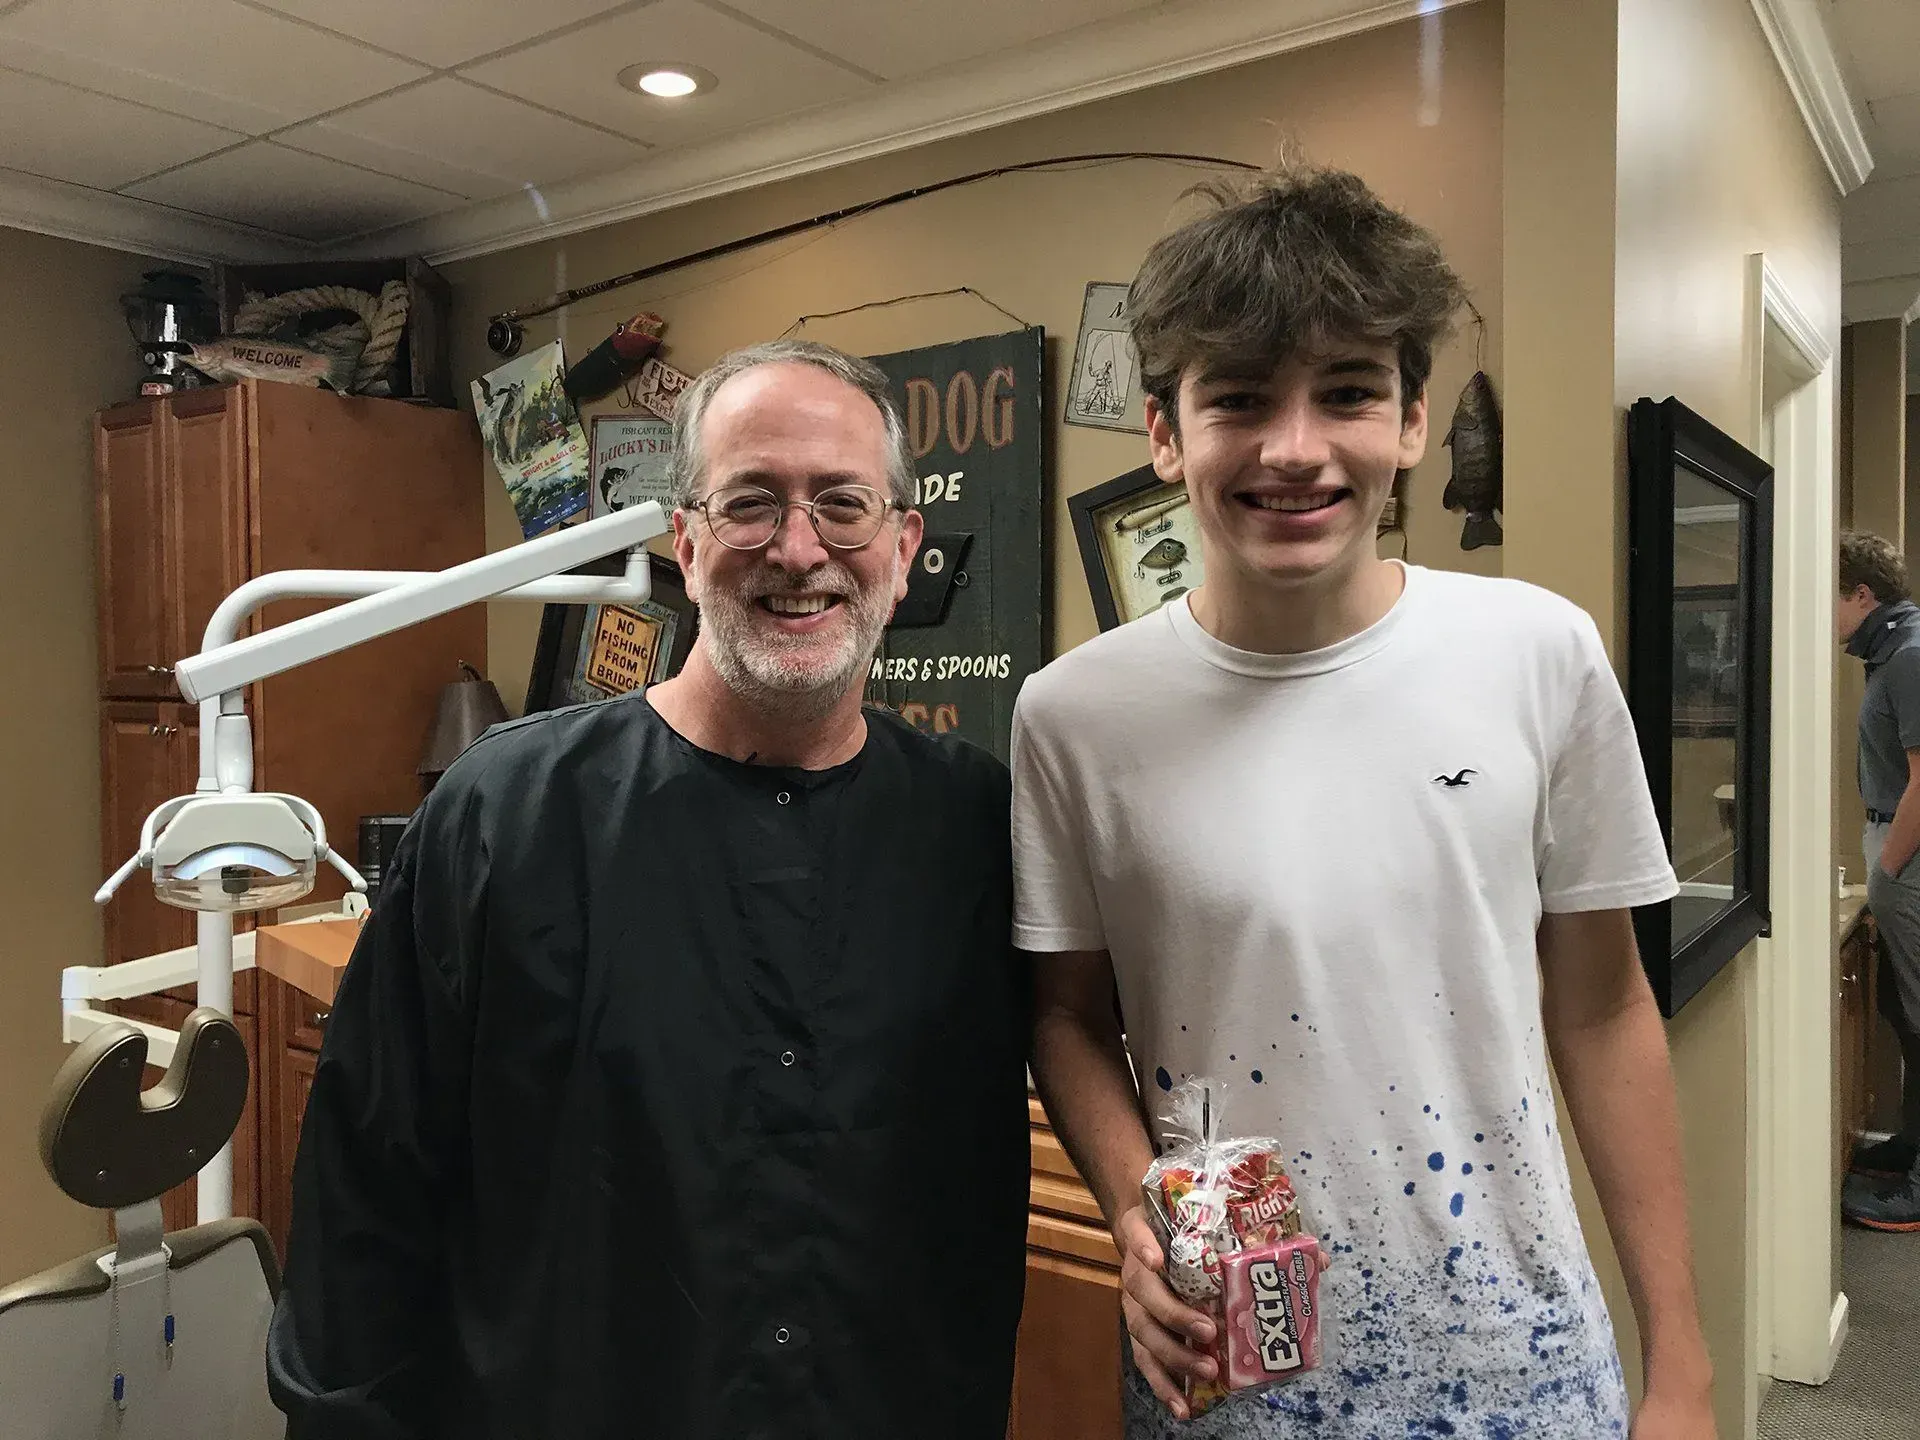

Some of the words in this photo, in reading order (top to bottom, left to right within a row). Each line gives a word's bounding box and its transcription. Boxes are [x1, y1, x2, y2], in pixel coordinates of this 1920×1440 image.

[232, 346, 303, 368] WELCOME
[906, 365, 1017, 459] DOG
[599, 438, 657, 466] LUCKY'S
[521, 462, 544, 479] WRIGHT
[617, 618, 635, 636] NO
[601, 631, 648, 660] FISHING
[604, 649, 638, 673] FROM
[867, 657, 919, 682] NERS
[920, 658, 934, 682] &
[936, 653, 1012, 681] SPOONS
[596, 663, 641, 691] BRIDGE
[1293, 1250, 1307, 1282] BUBBLE
[1278, 1270, 1290, 1294] FLAVOR
[1283, 1294, 1296, 1322] LASTING
[1300, 1283, 1312, 1317] CLASSIC
[1249, 1262, 1302, 1371] Extra
[1287, 1322, 1298, 1339] LONG
